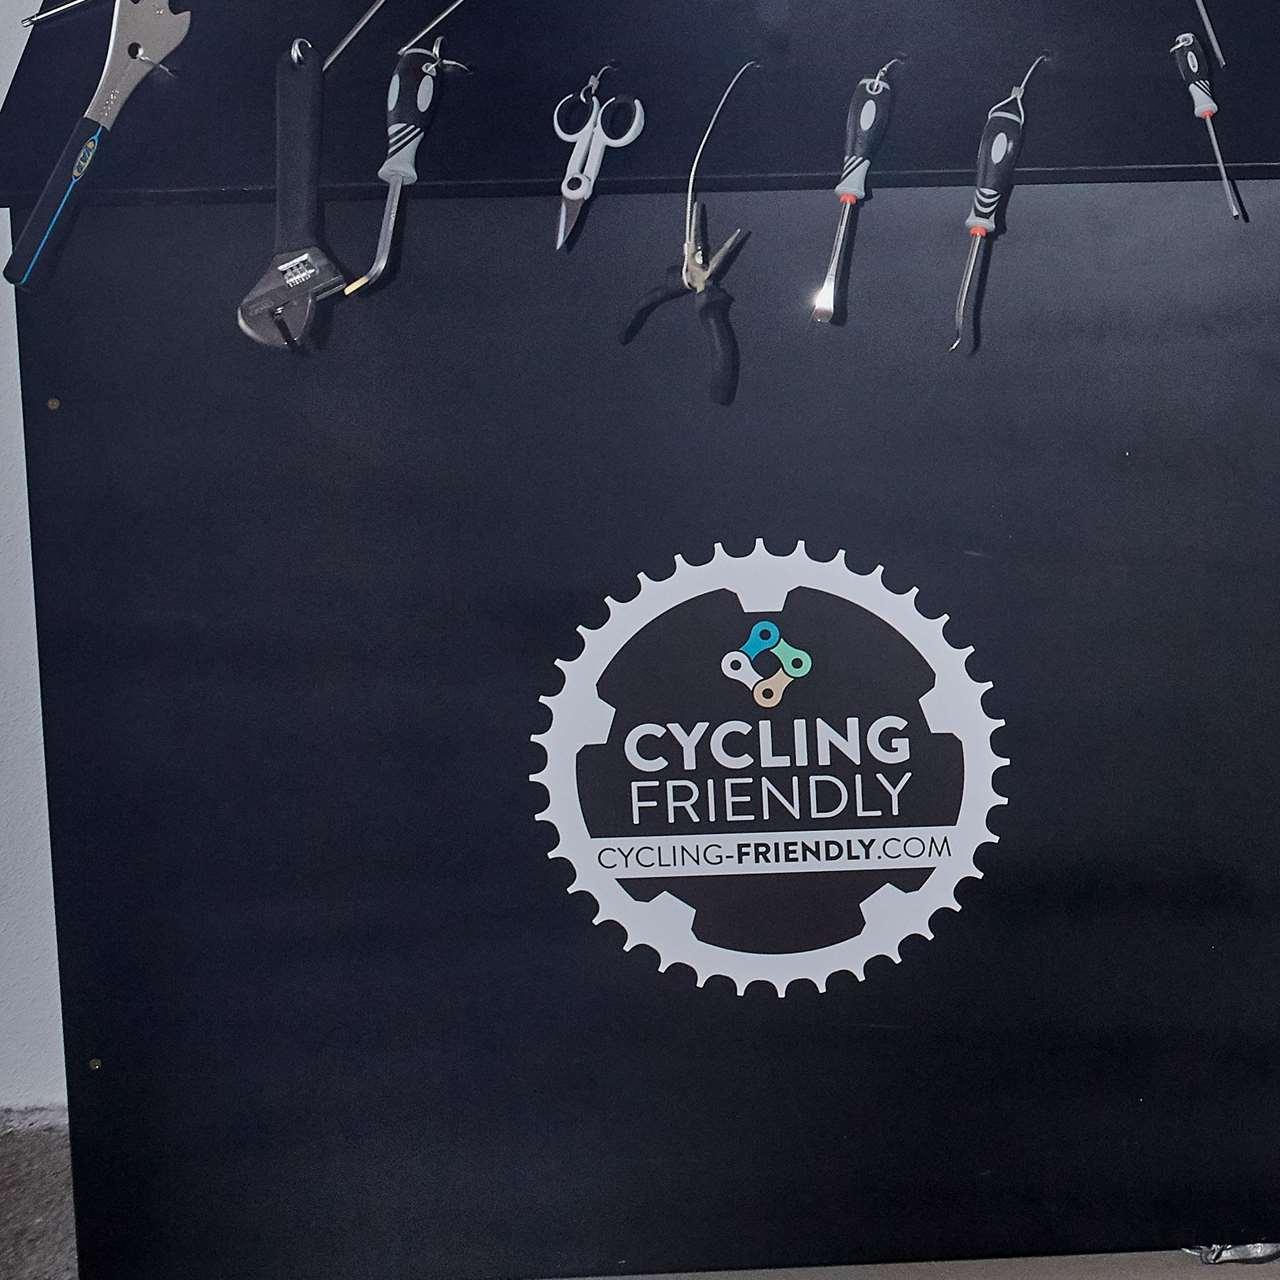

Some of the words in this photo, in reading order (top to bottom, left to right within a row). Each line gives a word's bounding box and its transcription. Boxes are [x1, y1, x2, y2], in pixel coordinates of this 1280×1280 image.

[624, 715, 911, 772] CYCLING
[631, 772, 912, 825] FRIENDLY
[597, 836, 952, 870] CYCLING-FRIENDLY.COM
